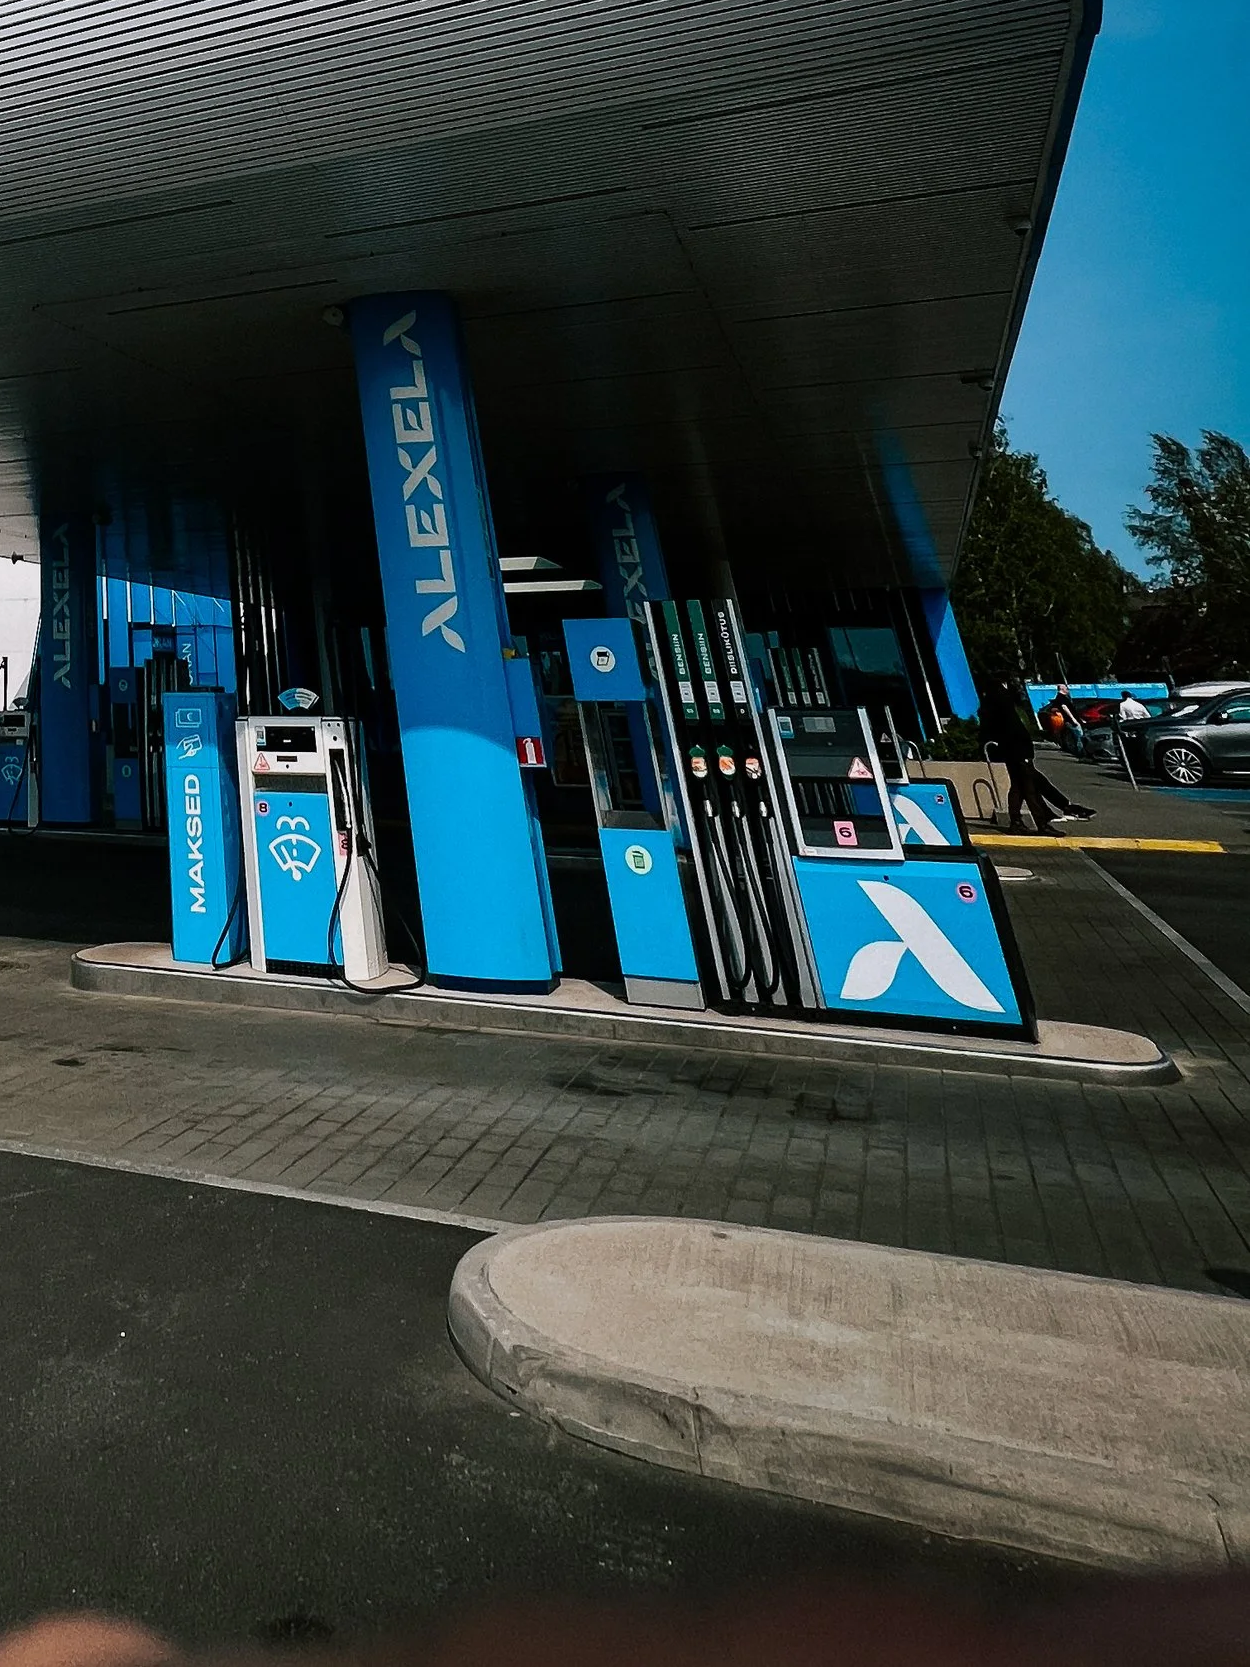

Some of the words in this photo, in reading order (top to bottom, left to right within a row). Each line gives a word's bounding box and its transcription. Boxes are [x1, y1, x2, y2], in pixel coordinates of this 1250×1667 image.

[382, 309, 466, 653] ALEXELA
[52, 522, 72, 689] ALEXELA
[697, 633, 712, 675] BENSIIN
[258, 803, 268, 813] 8
[184, 773, 207, 914] MAKSED
[838, 826, 853, 838] 6
[958, 885, 974, 899] 6
